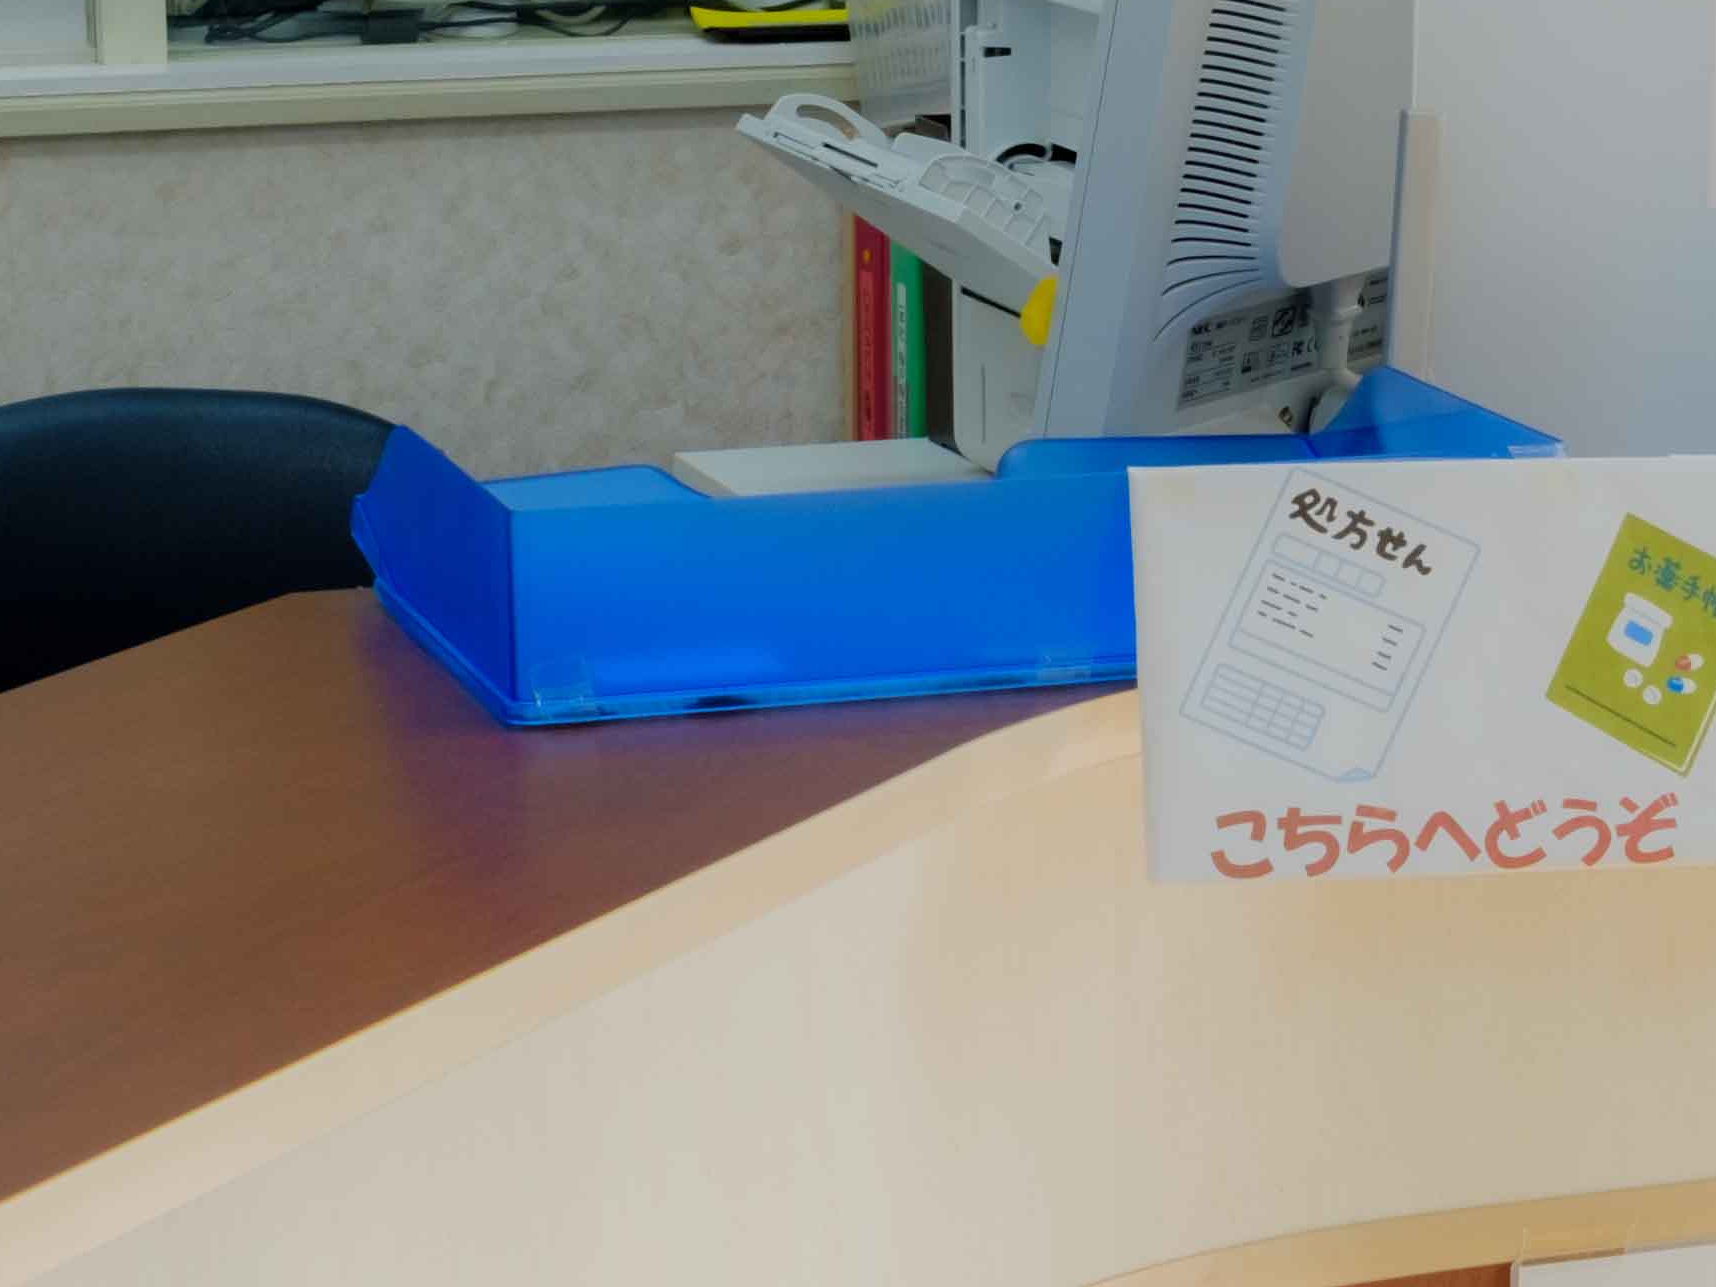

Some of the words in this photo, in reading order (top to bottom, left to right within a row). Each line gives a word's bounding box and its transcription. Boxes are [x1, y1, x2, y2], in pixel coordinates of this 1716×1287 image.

[1290, 488, 1432, 577] 処方せん
[1210, 792, 1680, 879] こちらへどうぞ
